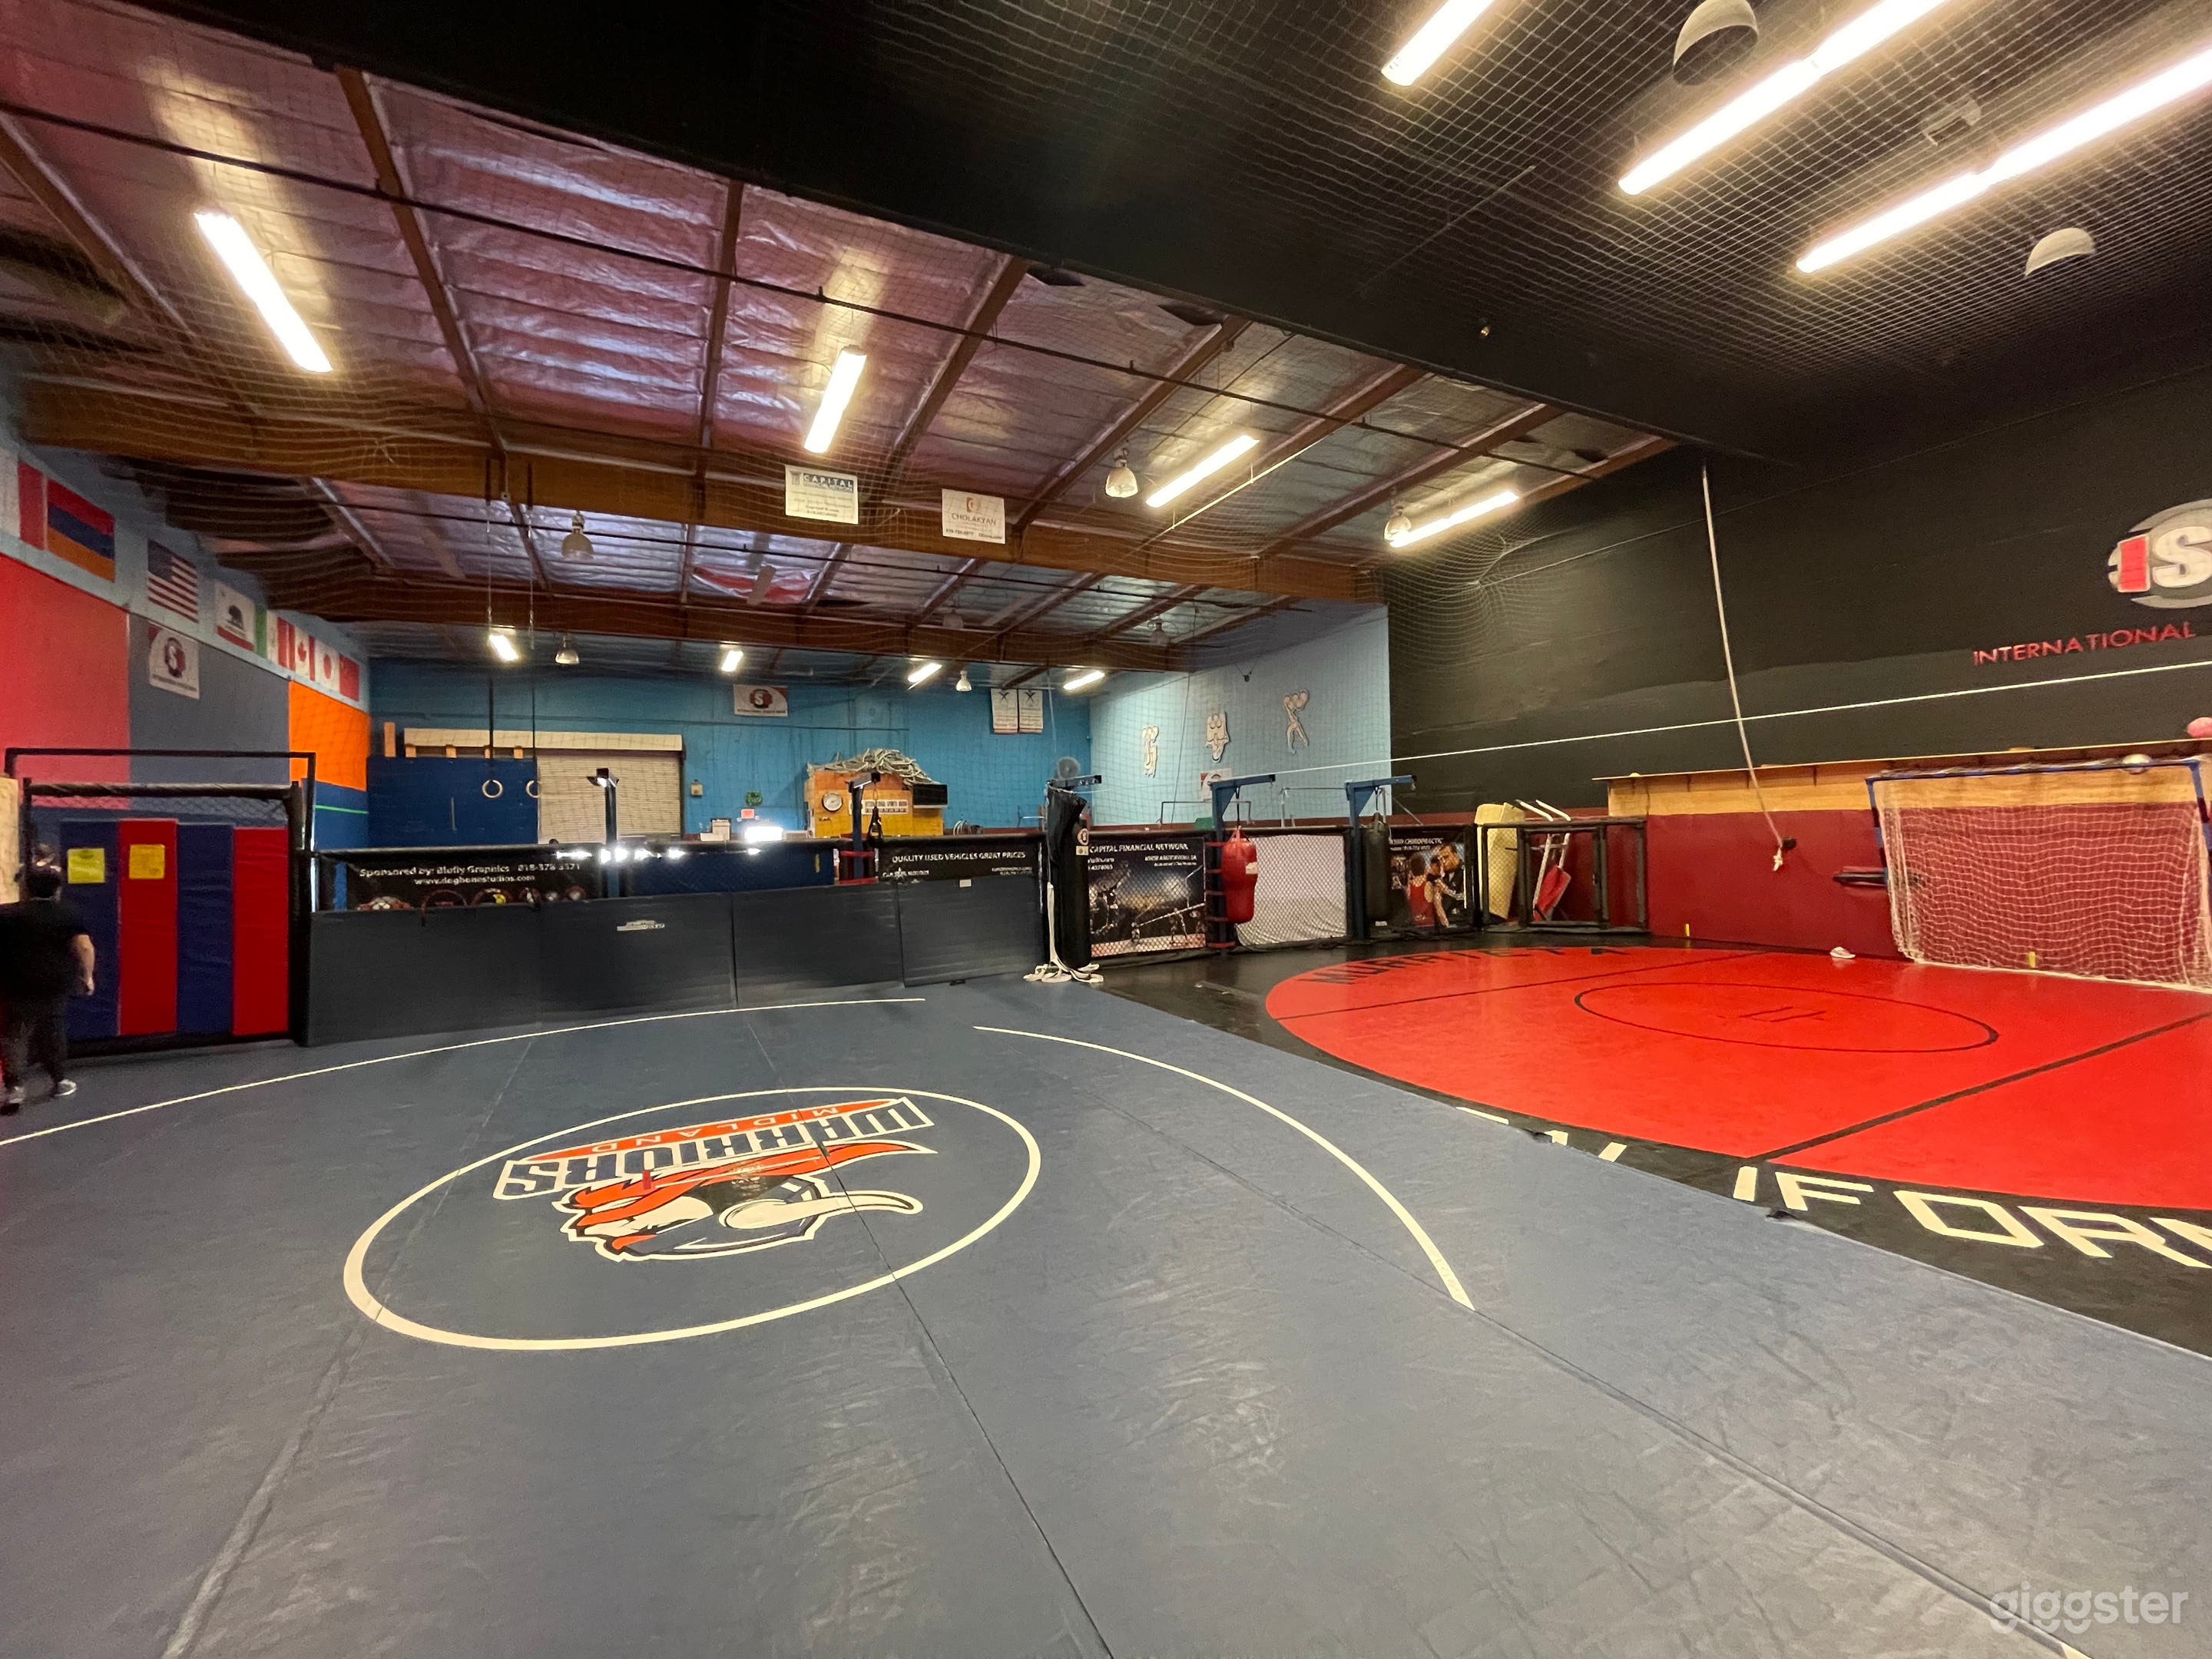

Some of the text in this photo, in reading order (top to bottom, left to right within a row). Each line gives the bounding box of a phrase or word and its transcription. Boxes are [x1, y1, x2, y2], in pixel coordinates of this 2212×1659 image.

[803, 474, 853, 488] CAPITAL
[952, 512, 996, 525] CHOLAKYAN
[1972, 621, 2197, 666] INTERNATIONAL
[1089, 843, 1189, 853] CAPITAL FINANCIAL NETWORK
[892, 853, 923, 863] QUALITY
[979, 851, 1001, 859] GREAT
[359, 866, 417, 878] Sponsored
[467, 865, 510, 874] Graphics
[591, 1106, 838, 1153] MIDLAND
[498, 1098, 931, 1197] WARRIORS
